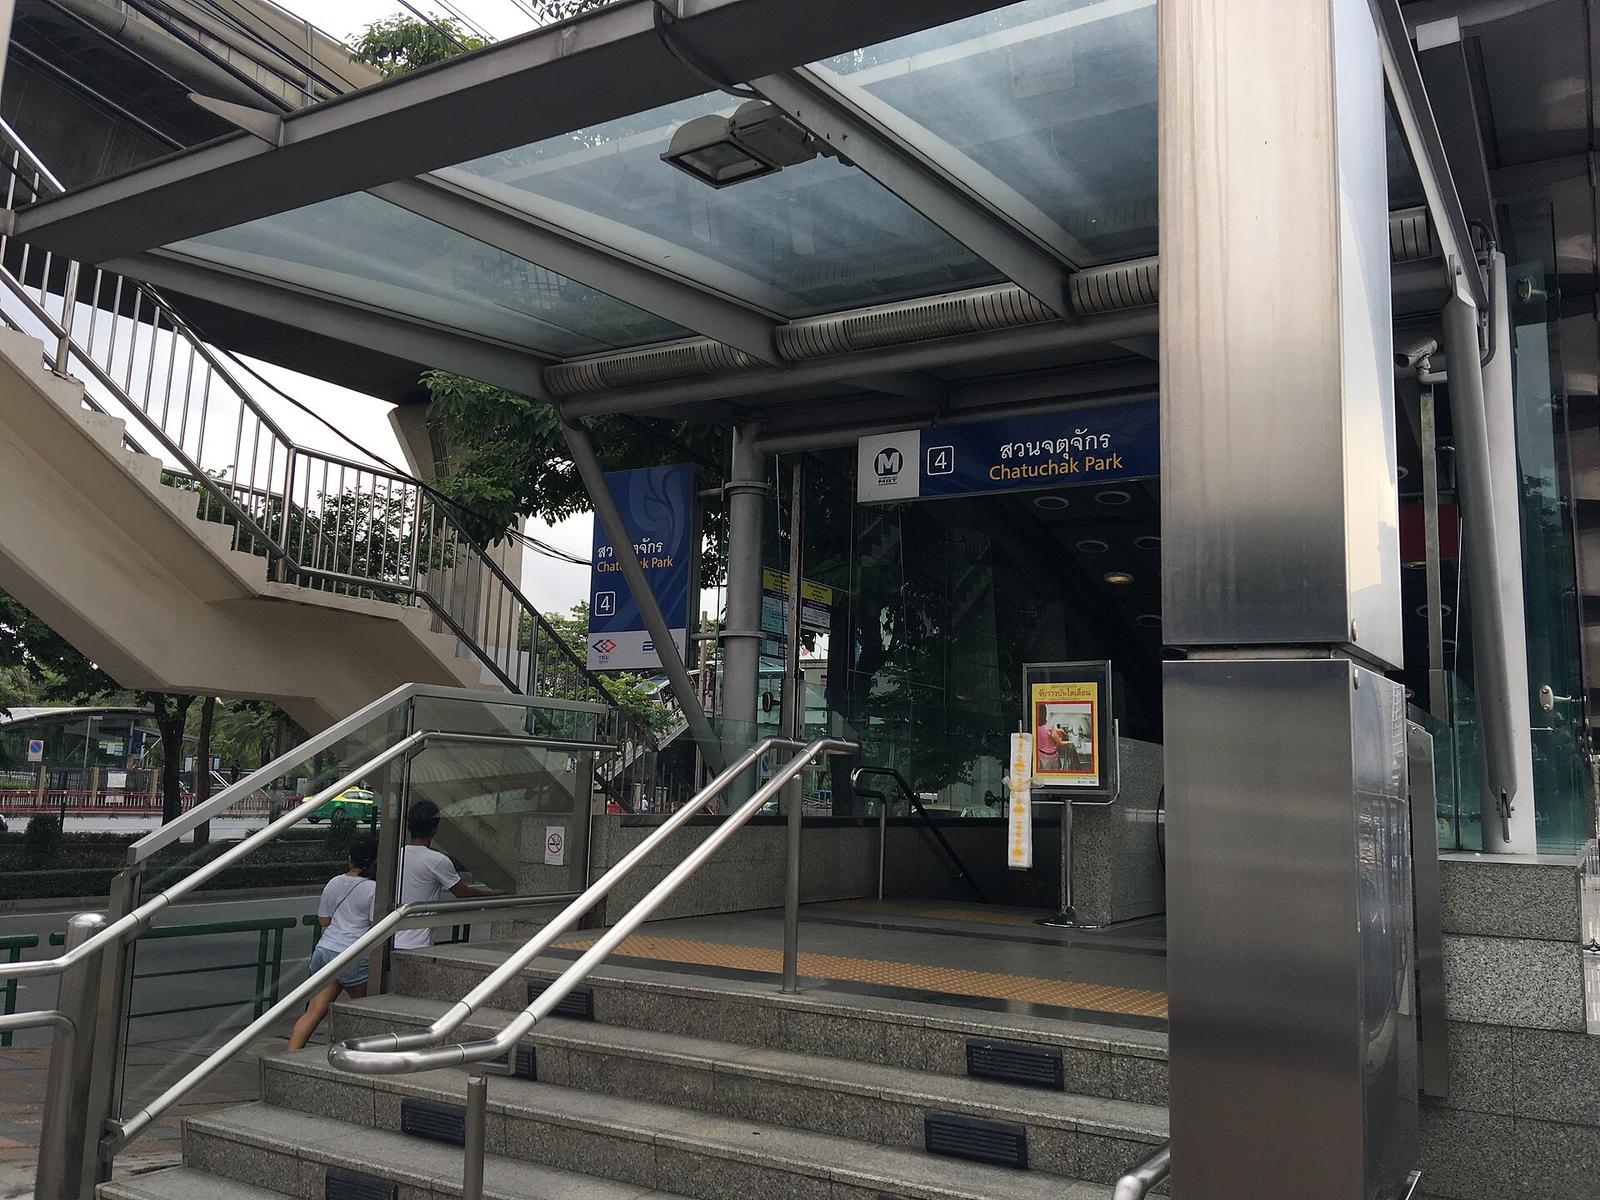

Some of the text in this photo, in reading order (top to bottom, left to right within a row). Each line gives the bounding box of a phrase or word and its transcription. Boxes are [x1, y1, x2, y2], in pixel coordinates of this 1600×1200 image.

[999, 428, 1111, 460] สวนจตุจักร
[934, 451, 947, 470] 4
[989, 452, 1124, 480] Chatuchak Park
[597, 555, 674, 573] Chatk Park
[600, 595, 611, 611] 4
